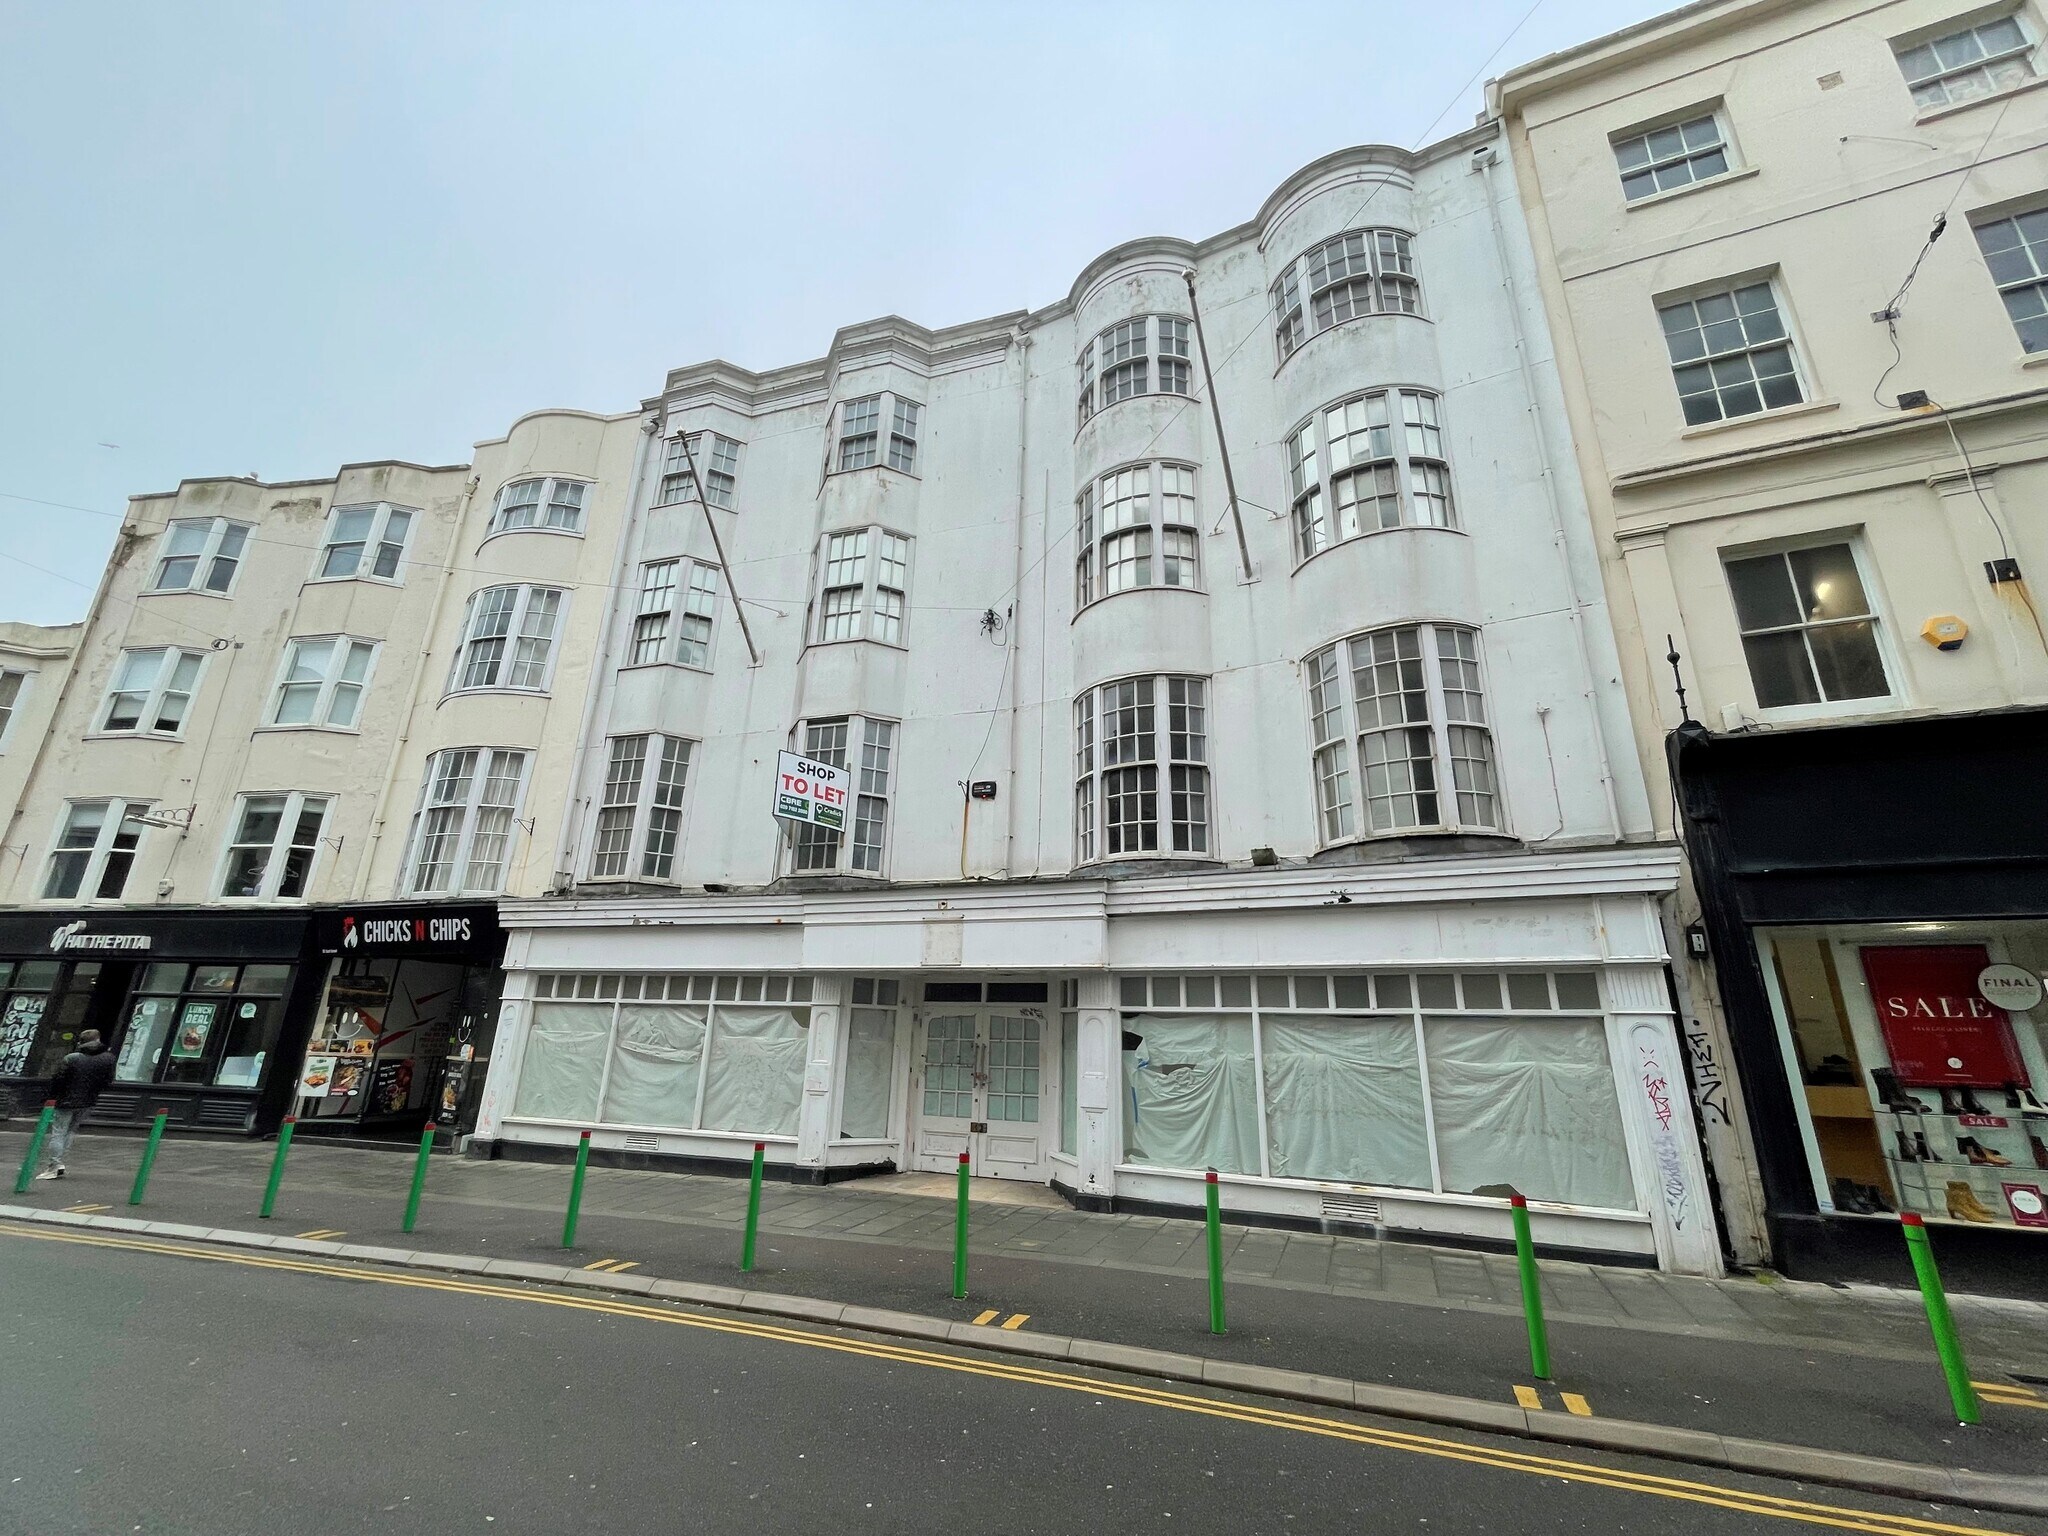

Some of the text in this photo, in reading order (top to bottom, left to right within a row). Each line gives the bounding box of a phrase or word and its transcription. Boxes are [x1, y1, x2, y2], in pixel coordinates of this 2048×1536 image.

[797, 761, 835, 781] SHOP
[782, 773, 845, 805] TO LET
[780, 796, 802, 807] CBRE
[364, 918, 471, 942] CHICKS N CHIPS
[1983, 977, 2035, 987] FINAL
[189, 1005, 213, 1014] LUNCH
[1888, 996, 1993, 1018] SALE
[185, 1014, 209, 1025] DEAL
[1968, 1117, 1997, 1126] SALE
